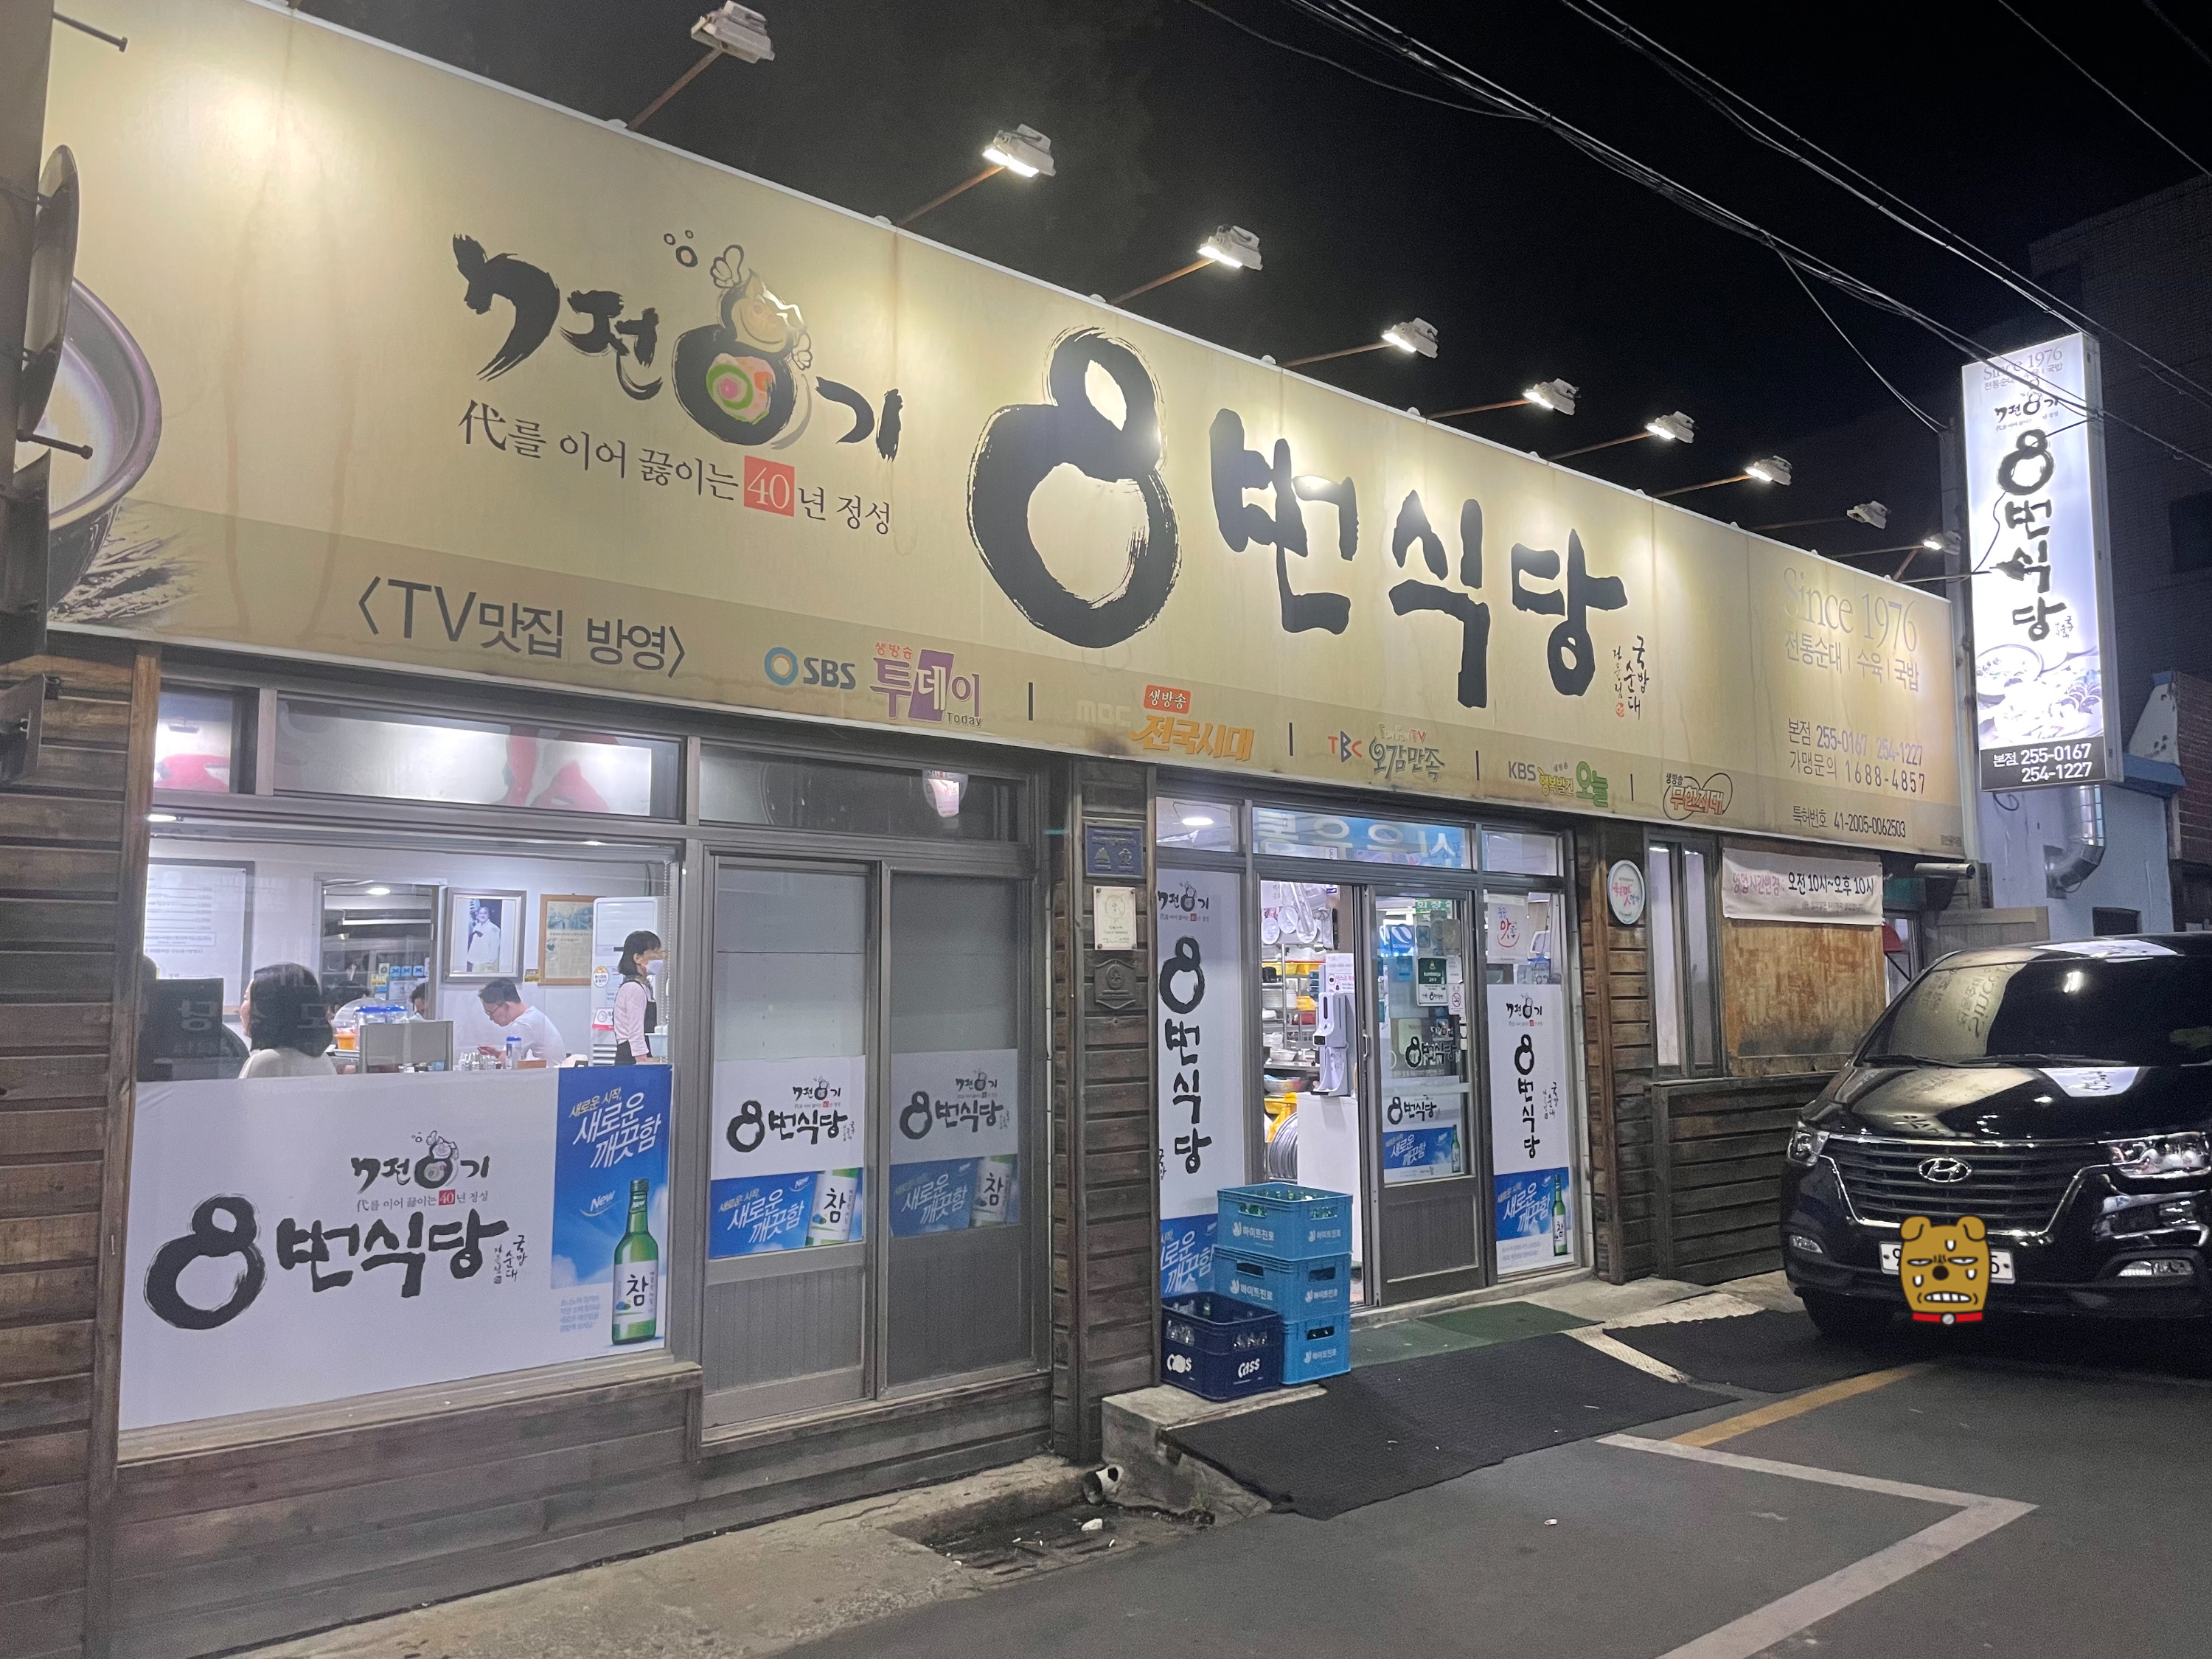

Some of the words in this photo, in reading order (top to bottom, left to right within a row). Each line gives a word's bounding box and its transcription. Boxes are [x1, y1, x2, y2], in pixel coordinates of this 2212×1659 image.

[2028, 345, 2063, 368] 1976
[458, 400, 546, 459] 代를
[560, 431, 627, 479] 이어
[638, 447, 739, 501] 끓이는
[835, 495, 892, 535] 정성
[967, 325, 1627, 708] 8번식당
[1996, 428, 2067, 641] 8번식당
[1783, 567, 1854, 635] Since
[1861, 593, 1919, 653] 1976
[874, 641, 914, 660] 생방송
[1632, 635, 1650, 694] 국밥
[1784, 630, 1843, 674] 전통순대
[1856, 649, 1883, 684] 수육
[1894, 658, 1919, 692] 국밥
[803, 656, 857, 690] SBS
[870, 657, 981, 720] 투데이
[1623, 660, 1641, 720] 순대
[1147, 687, 1187, 710] 생방송
[947, 712, 982, 727] Today
[1130, 714, 1254, 762] 전국시대
[1328, 731, 1363, 762] TBC
[1368, 736, 1445, 782] 오감만족
[1788, 717, 1811, 746] 본점
[1816, 724, 1868, 757] 255-0167
[1876, 737, 1924, 767] 254-1227
[1992, 753, 2019, 768] 본점
[2020, 742, 2092, 766] 255-0167
[1508, 761, 1537, 781] KBS
[1537, 768, 1574, 797] 행복발견
[1576, 761, 1609, 807] 오늘
[1666, 773, 1683, 786] 생방송
[1790, 749, 1837, 780] 가맹문의
[1845, 761, 1926, 795] 1688-4857
[2021, 762, 2093, 783] 254-1227
[1670, 785, 1725, 815] 무한지대
[1792, 805, 1828, 830] 특허번호
[1833, 812, 1907, 838] 41-2005-0062503
[1788, 872, 1806, 896] 오전
[1854, 876, 1874, 896] 10시
[1158, 935, 1212, 1174] 8번식당
[569, 1095, 600, 1118] 새로운
[602, 1086, 622, 1104] 시작,
[899, 1091, 1004, 1140] 8번식당
[1387, 1096, 1438, 1125] 8번식당
[1514, 1034, 1540, 1158] 8번식당
[572, 1091, 644, 1145] 새로운
[726, 1099, 849, 1153] 8번식당
[590, 1113, 662, 1169] 깨끗함
[383, 1197, 403, 1211] 이어
[406, 1194, 437, 1208] 끓이는
[469, 1190, 489, 1203] 정성
[590, 1190, 616, 1211] New
[823, 1187, 846, 1223] 참
[901, 1173, 949, 1213] 새로운
[919, 1184, 968, 1224] 깨끗함
[983, 1172, 1004, 1206] 참
[1503, 1182, 1537, 1221] 새로운
[726, 1189, 784, 1231] 새로운
[748, 1200, 805, 1244] 깨끗함
[1517, 1192, 1551, 1233] 깨끗함
[1161, 1230, 1196, 1270] 로운
[1242, 1225, 1275, 1242] 하이트진로
[1316, 1228, 1342, 1239] 하이트진로
[144, 1193, 509, 1330] 8번식당
[1164, 1246, 1215, 1294] 깨끗함
[625, 1273, 650, 1307] 참
[1239, 1283, 1274, 1301] 하이트진로
[1312, 1288, 1338, 1300] 하이트진로
[1312, 1348, 1338, 1359] 하이트진로
